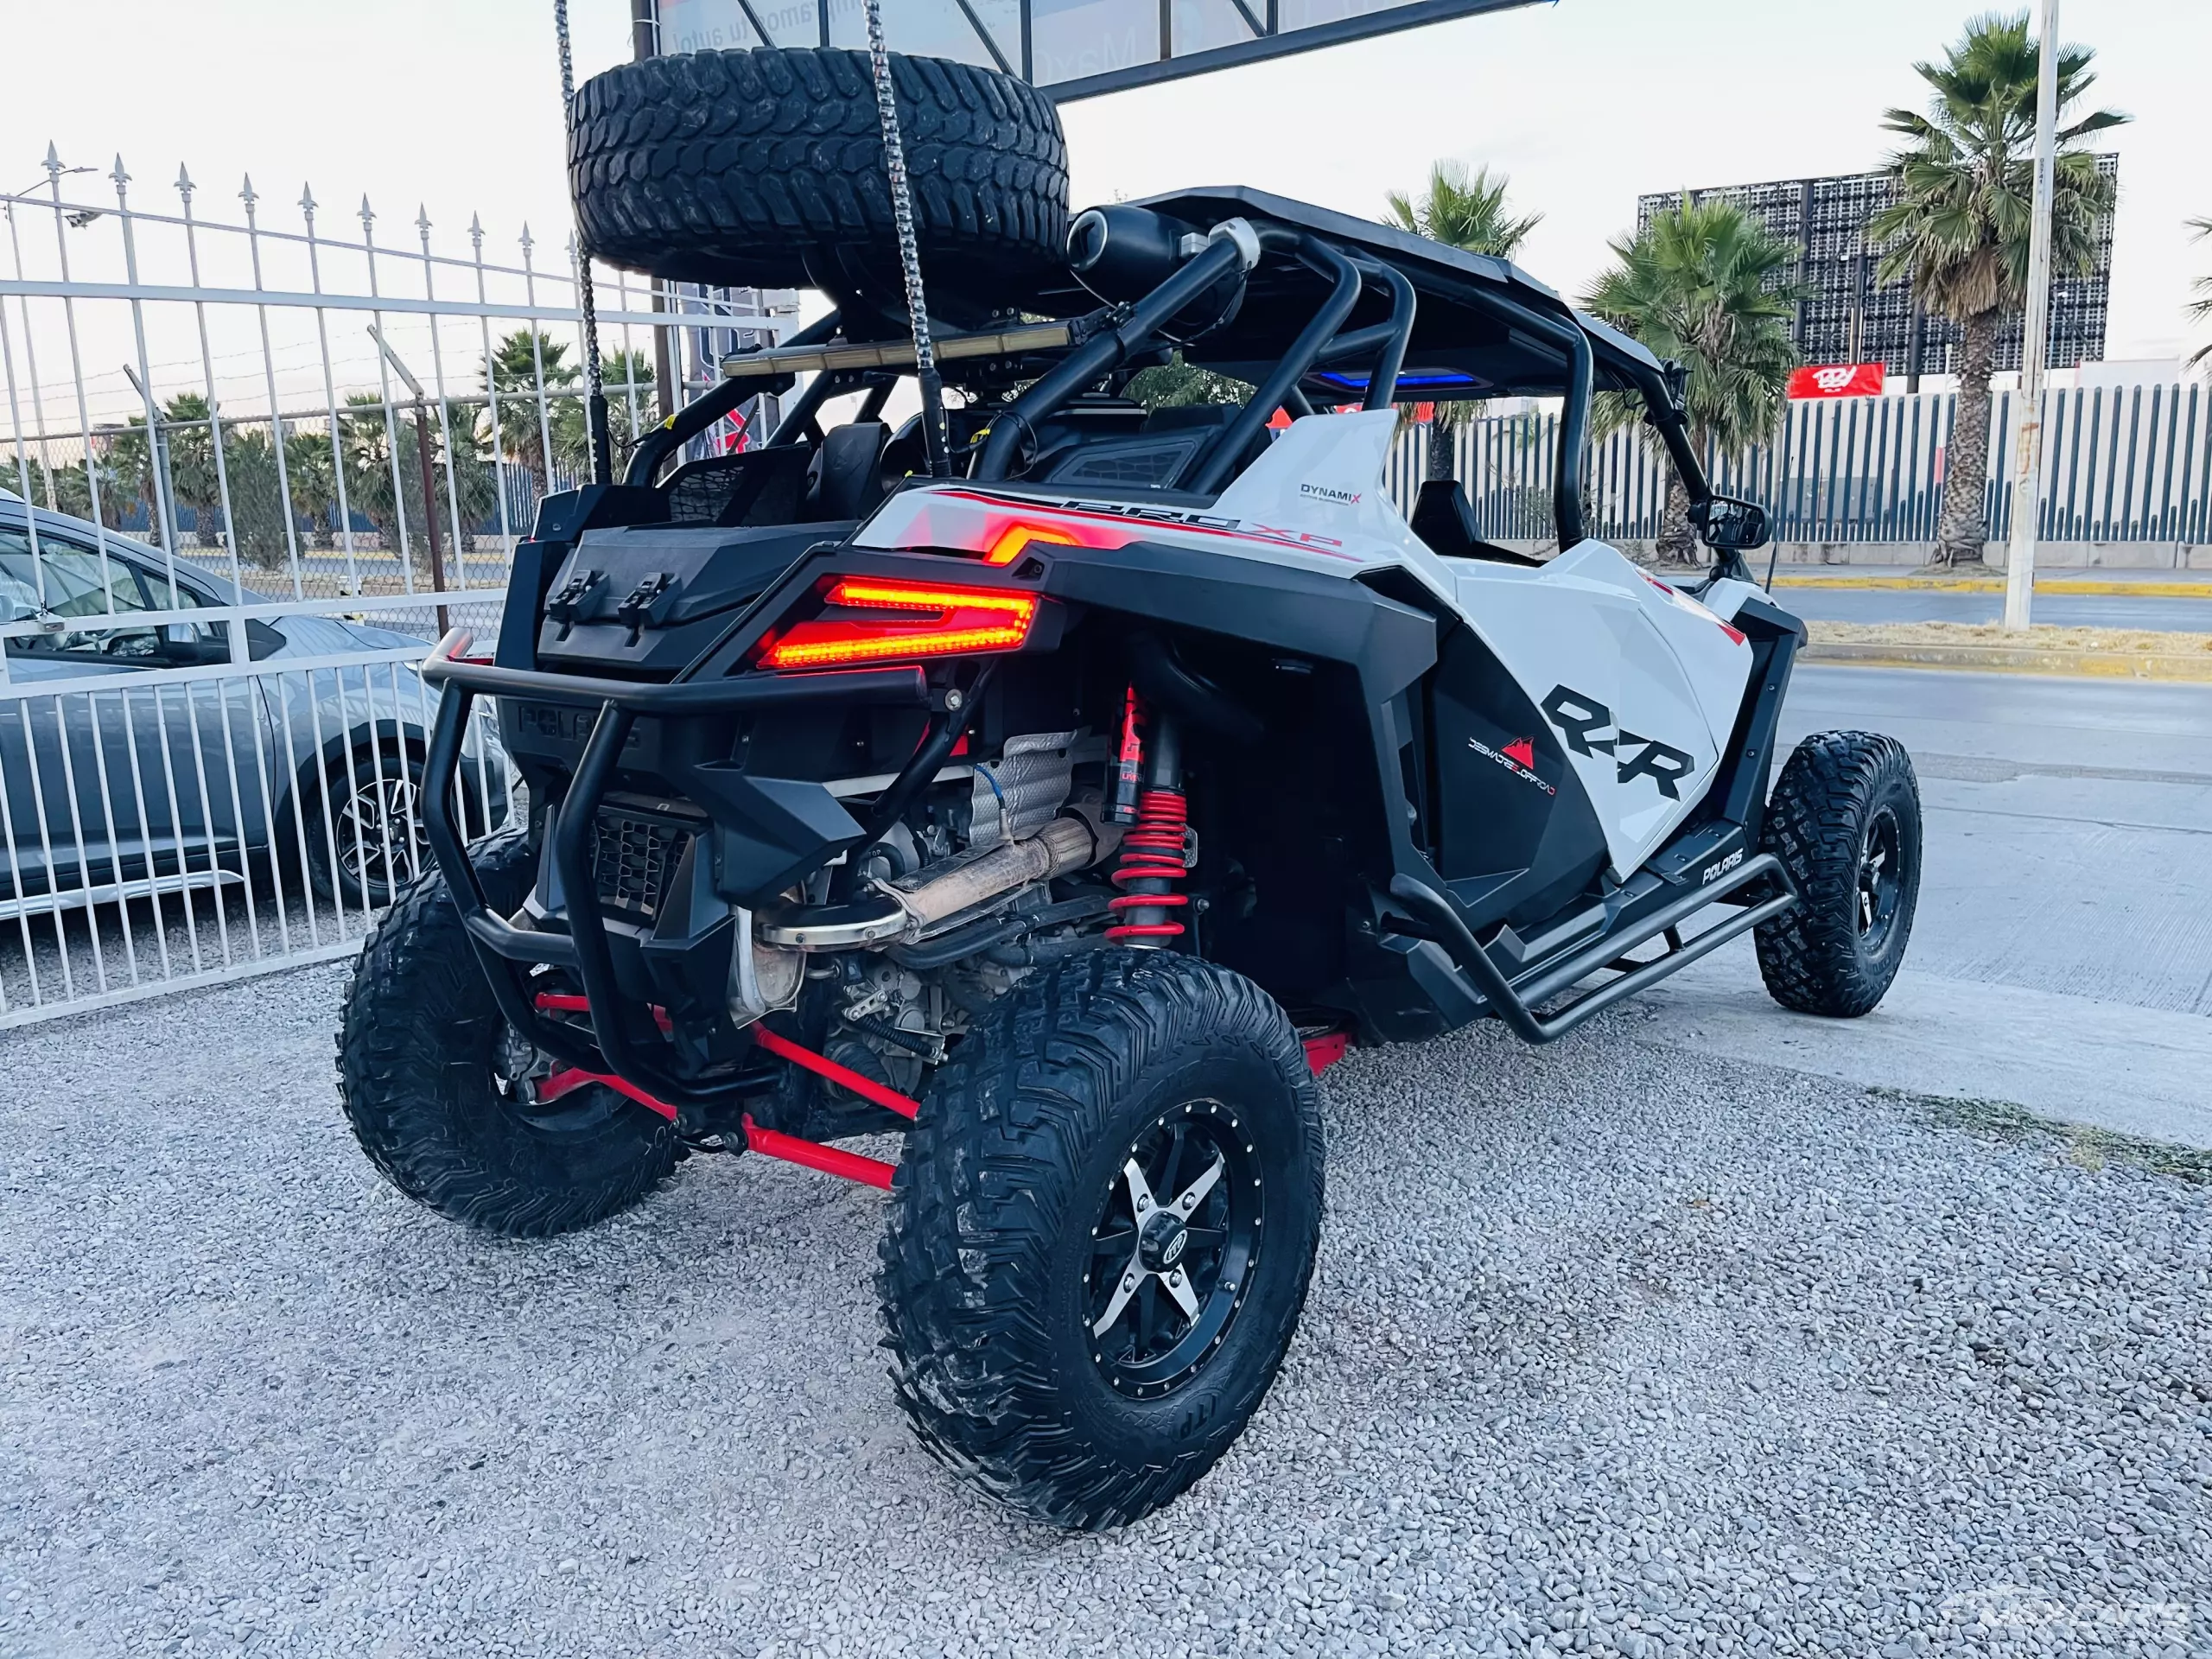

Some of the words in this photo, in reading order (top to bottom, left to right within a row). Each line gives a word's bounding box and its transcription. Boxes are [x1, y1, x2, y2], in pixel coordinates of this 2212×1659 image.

[1300, 483, 1362, 505] DYNAMIX
[1540, 683, 1694, 802] RZR
[1702, 848, 1744, 885] POLARIS
